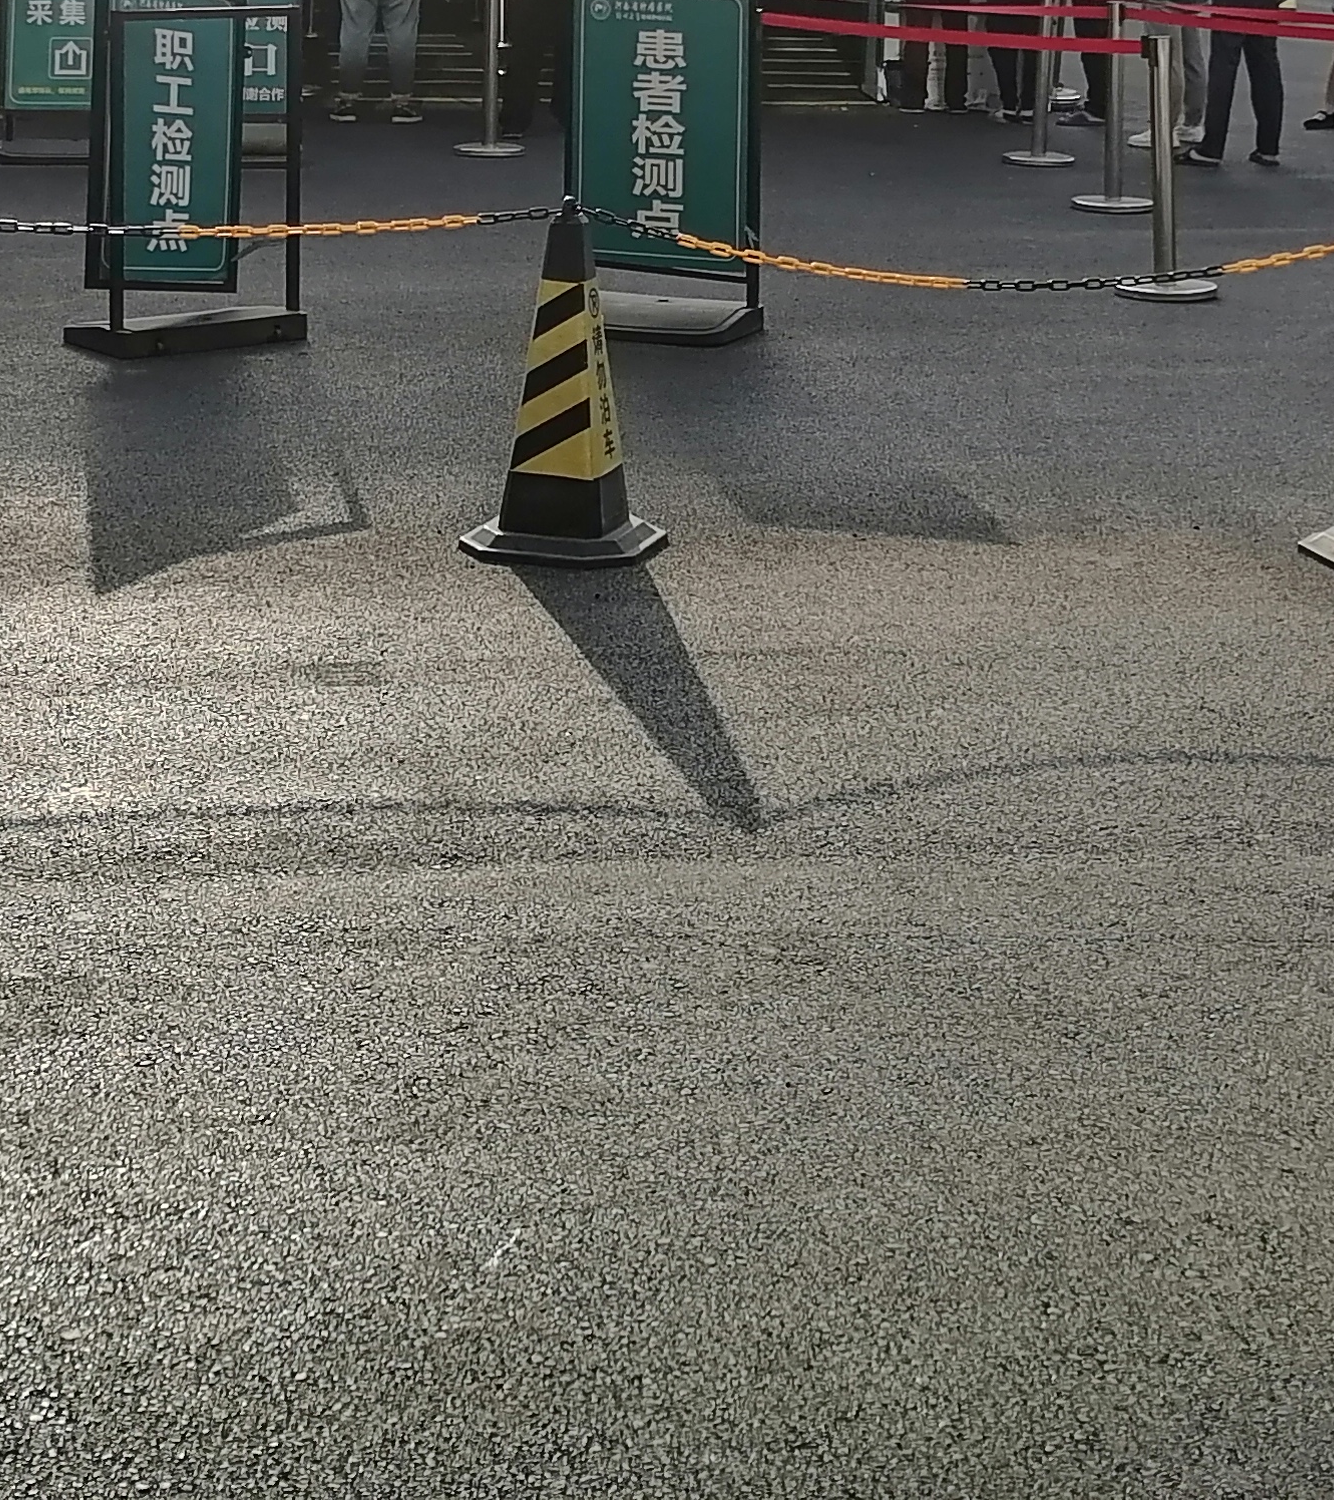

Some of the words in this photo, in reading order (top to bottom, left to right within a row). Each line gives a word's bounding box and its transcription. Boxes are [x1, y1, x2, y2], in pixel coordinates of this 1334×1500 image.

[27, 0, 86, 26] 采集
[146, 27, 194, 252] 职工检测点
[631, 29, 688, 239] 患者检测点
